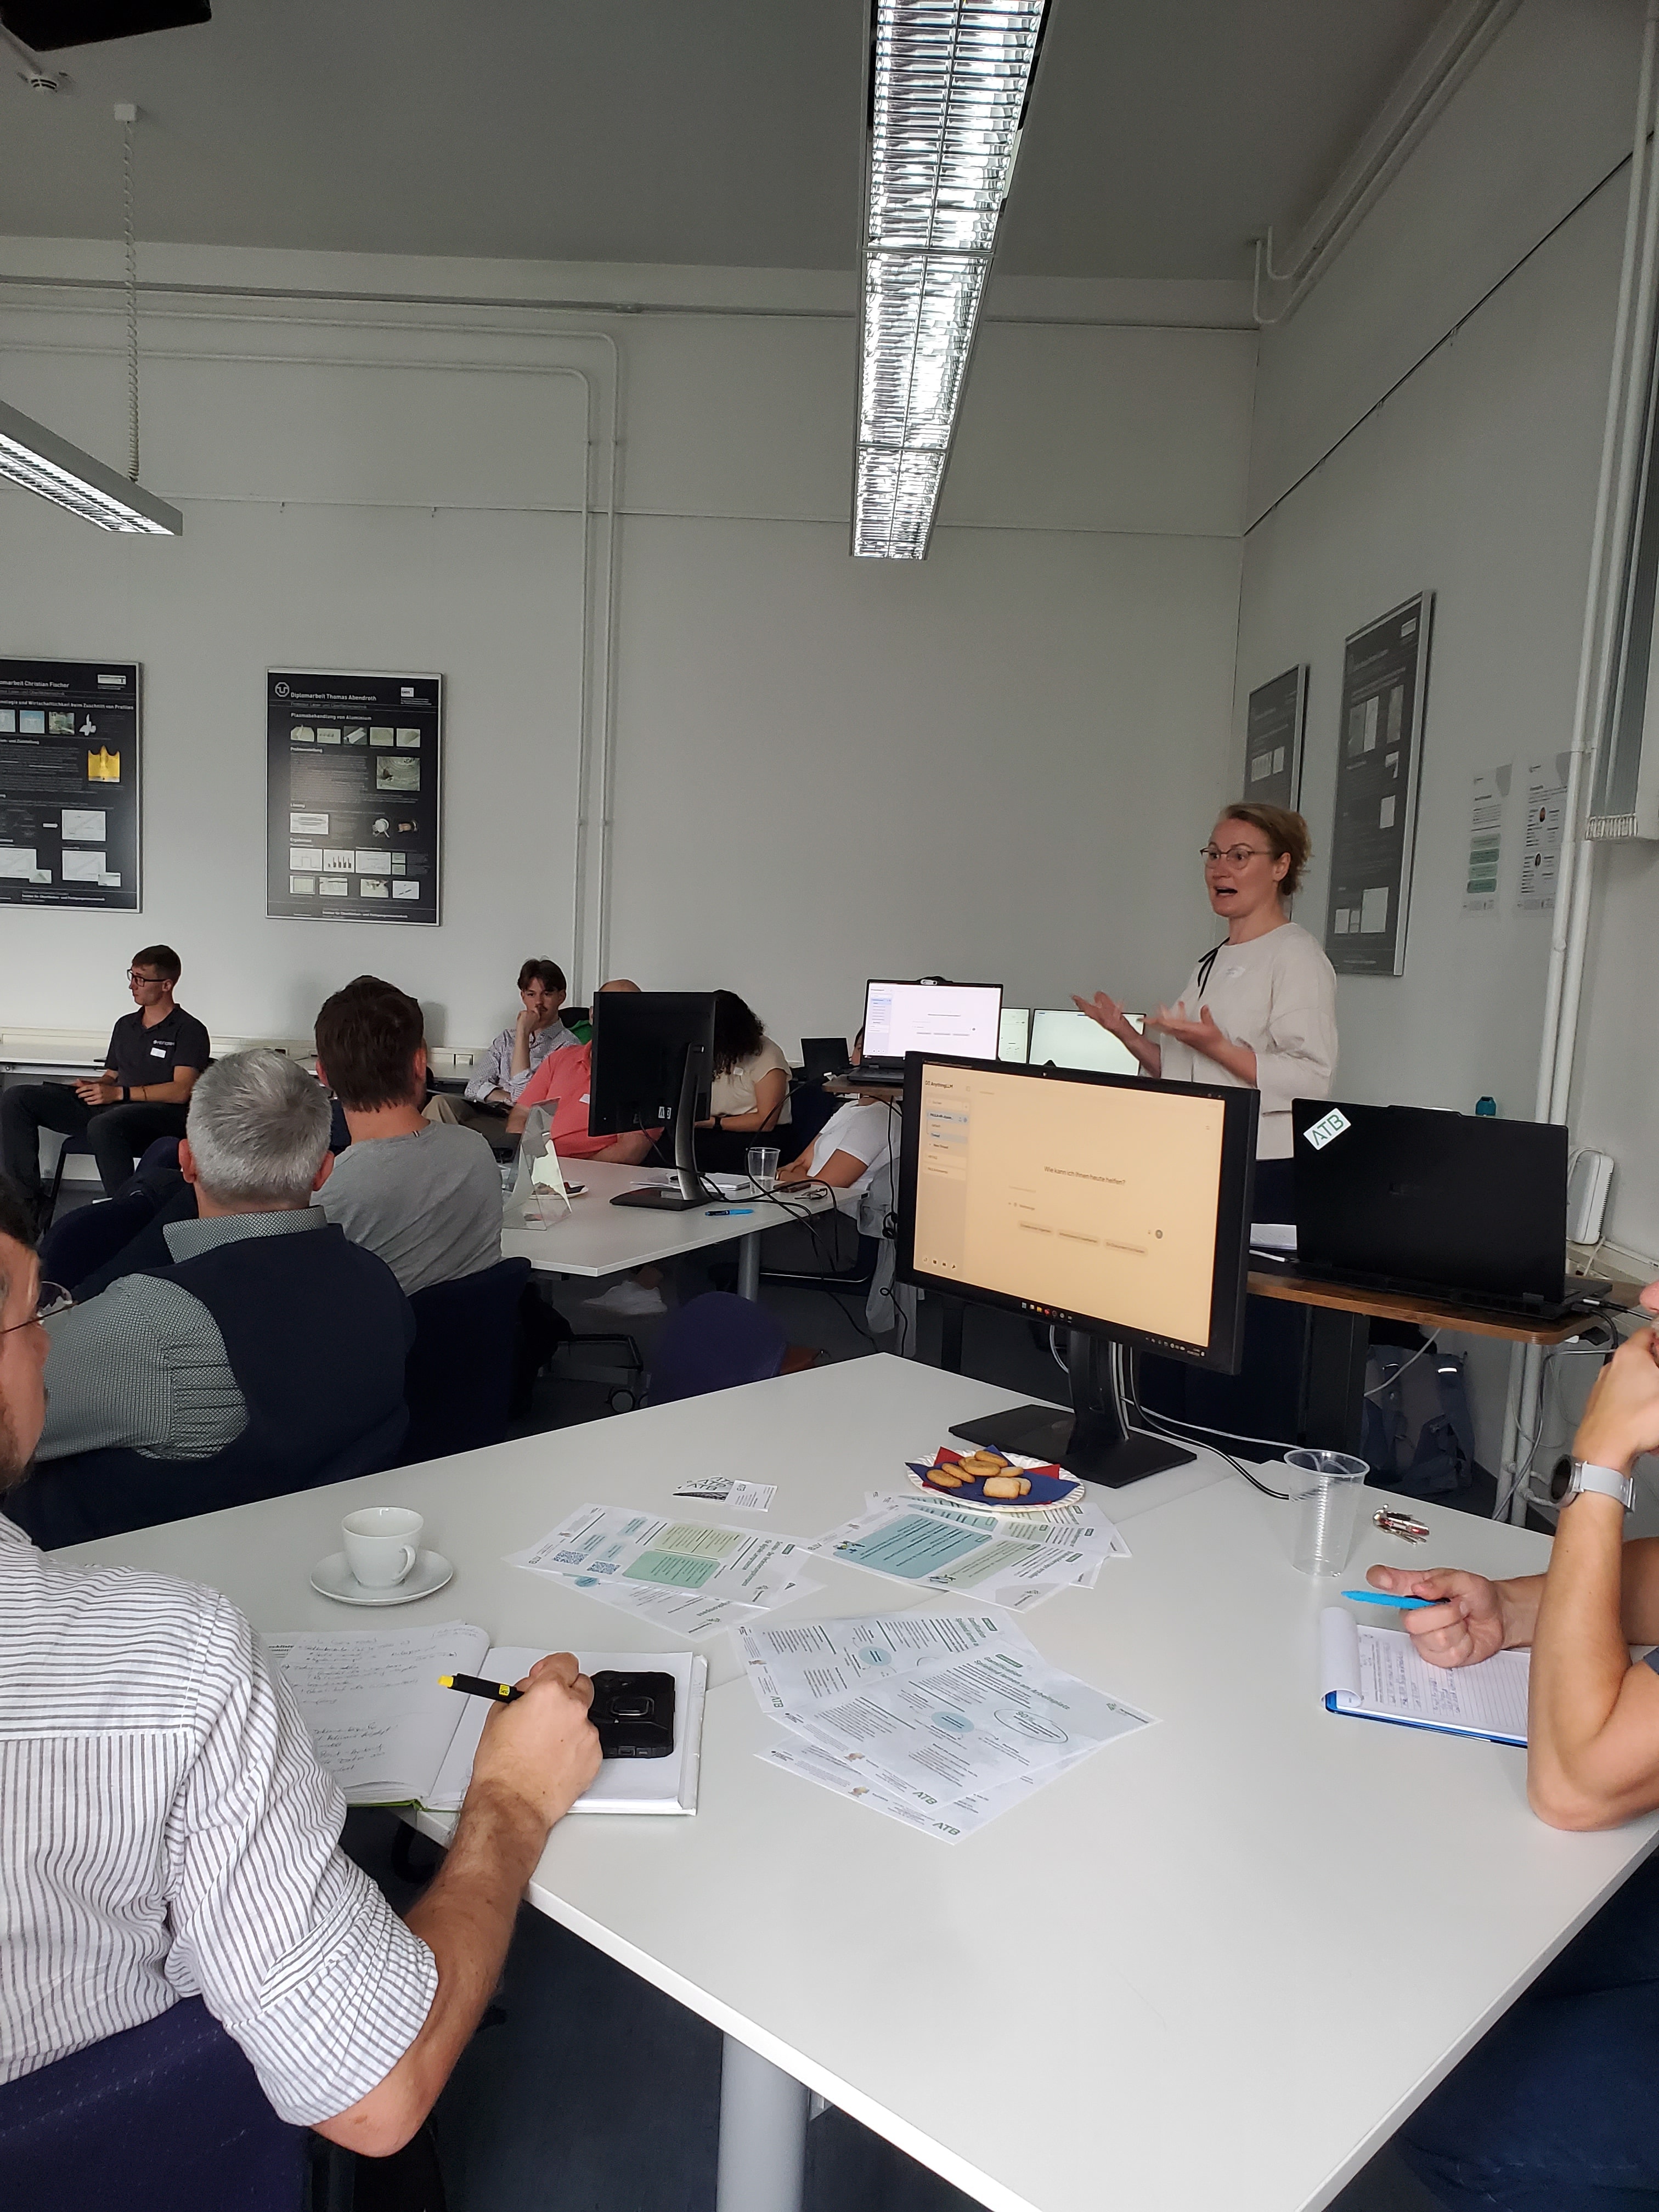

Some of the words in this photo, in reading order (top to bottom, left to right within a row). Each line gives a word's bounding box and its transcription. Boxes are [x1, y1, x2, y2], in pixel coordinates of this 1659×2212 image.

[1312, 1115, 1344, 1146] ATB
[1090, 1173, 1105, 1182] heute
[1105, 1176, 1126, 1185] helfen?
[686, 1483, 718, 1491] ATB
[984, 1657, 1022, 1677] Gamification
[974, 1660, 1002, 1675] Spielend
[1000, 1673, 1020, 1685] lernen
[1031, 1689, 1070, 1710] Arbeitsplatz
[770, 1695, 784, 1708] ATB
[912, 1791, 938, 1805] ATB
[933, 1822, 961, 1836] ATB
